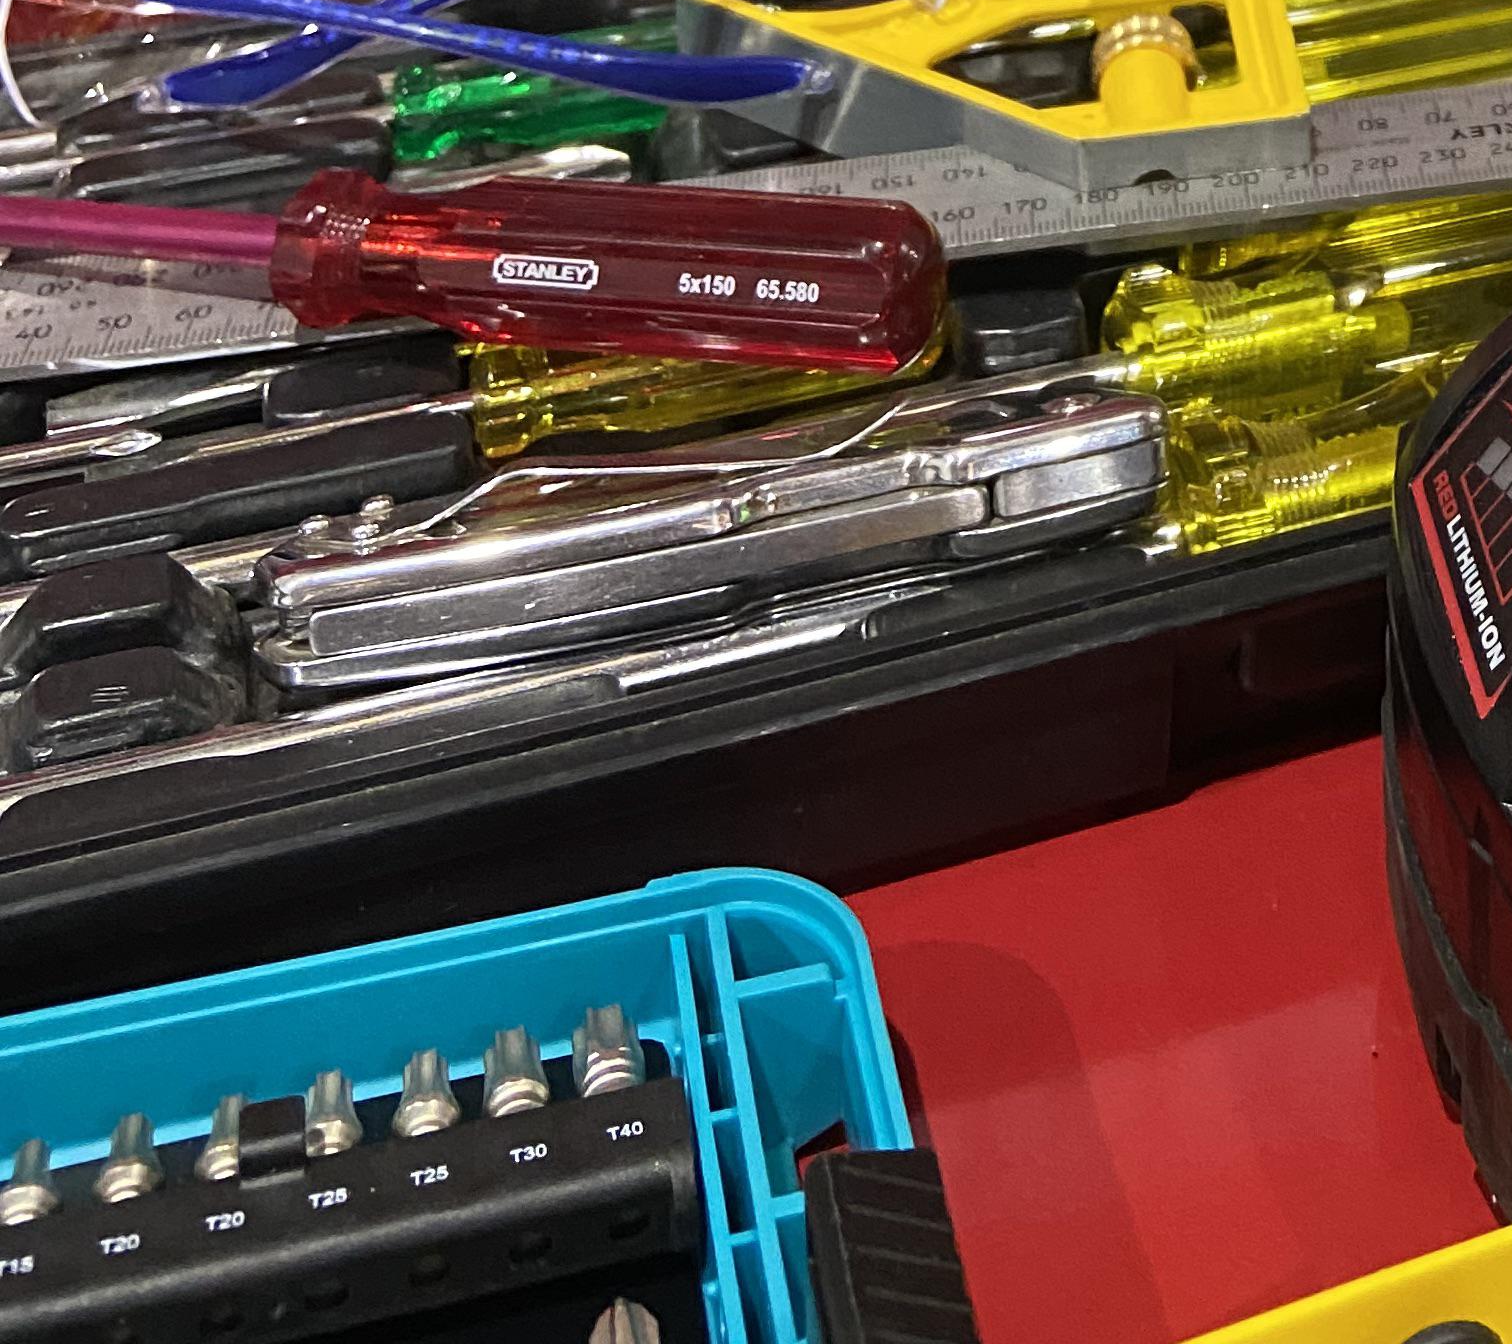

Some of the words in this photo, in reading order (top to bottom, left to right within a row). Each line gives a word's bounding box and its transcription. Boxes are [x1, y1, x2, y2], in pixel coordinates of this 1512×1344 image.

[1357, 117, 1389, 132] 80
[1003, 197, 1047, 215] 170
[1074, 188, 1118, 205] 180
[1213, 170, 1260, 188] 200
[1352, 155, 1398, 172] 220
[1419, 147, 1466, 164] 230
[502, 261, 589, 283] STANLEY
[679, 273, 736, 296] 5x150
[757, 279, 820, 303] 65.580
[1433, 469, 1507, 672] REDLITHIUM-ION
[100, 1233, 141, 1255] T20
[205, 1210, 246, 1232] T20
[308, 1187, 348, 1209] T25
[410, 1165, 449, 1187] T25
[510, 1143, 547, 1163] T30
[607, 1120, 644, 1141] T40
